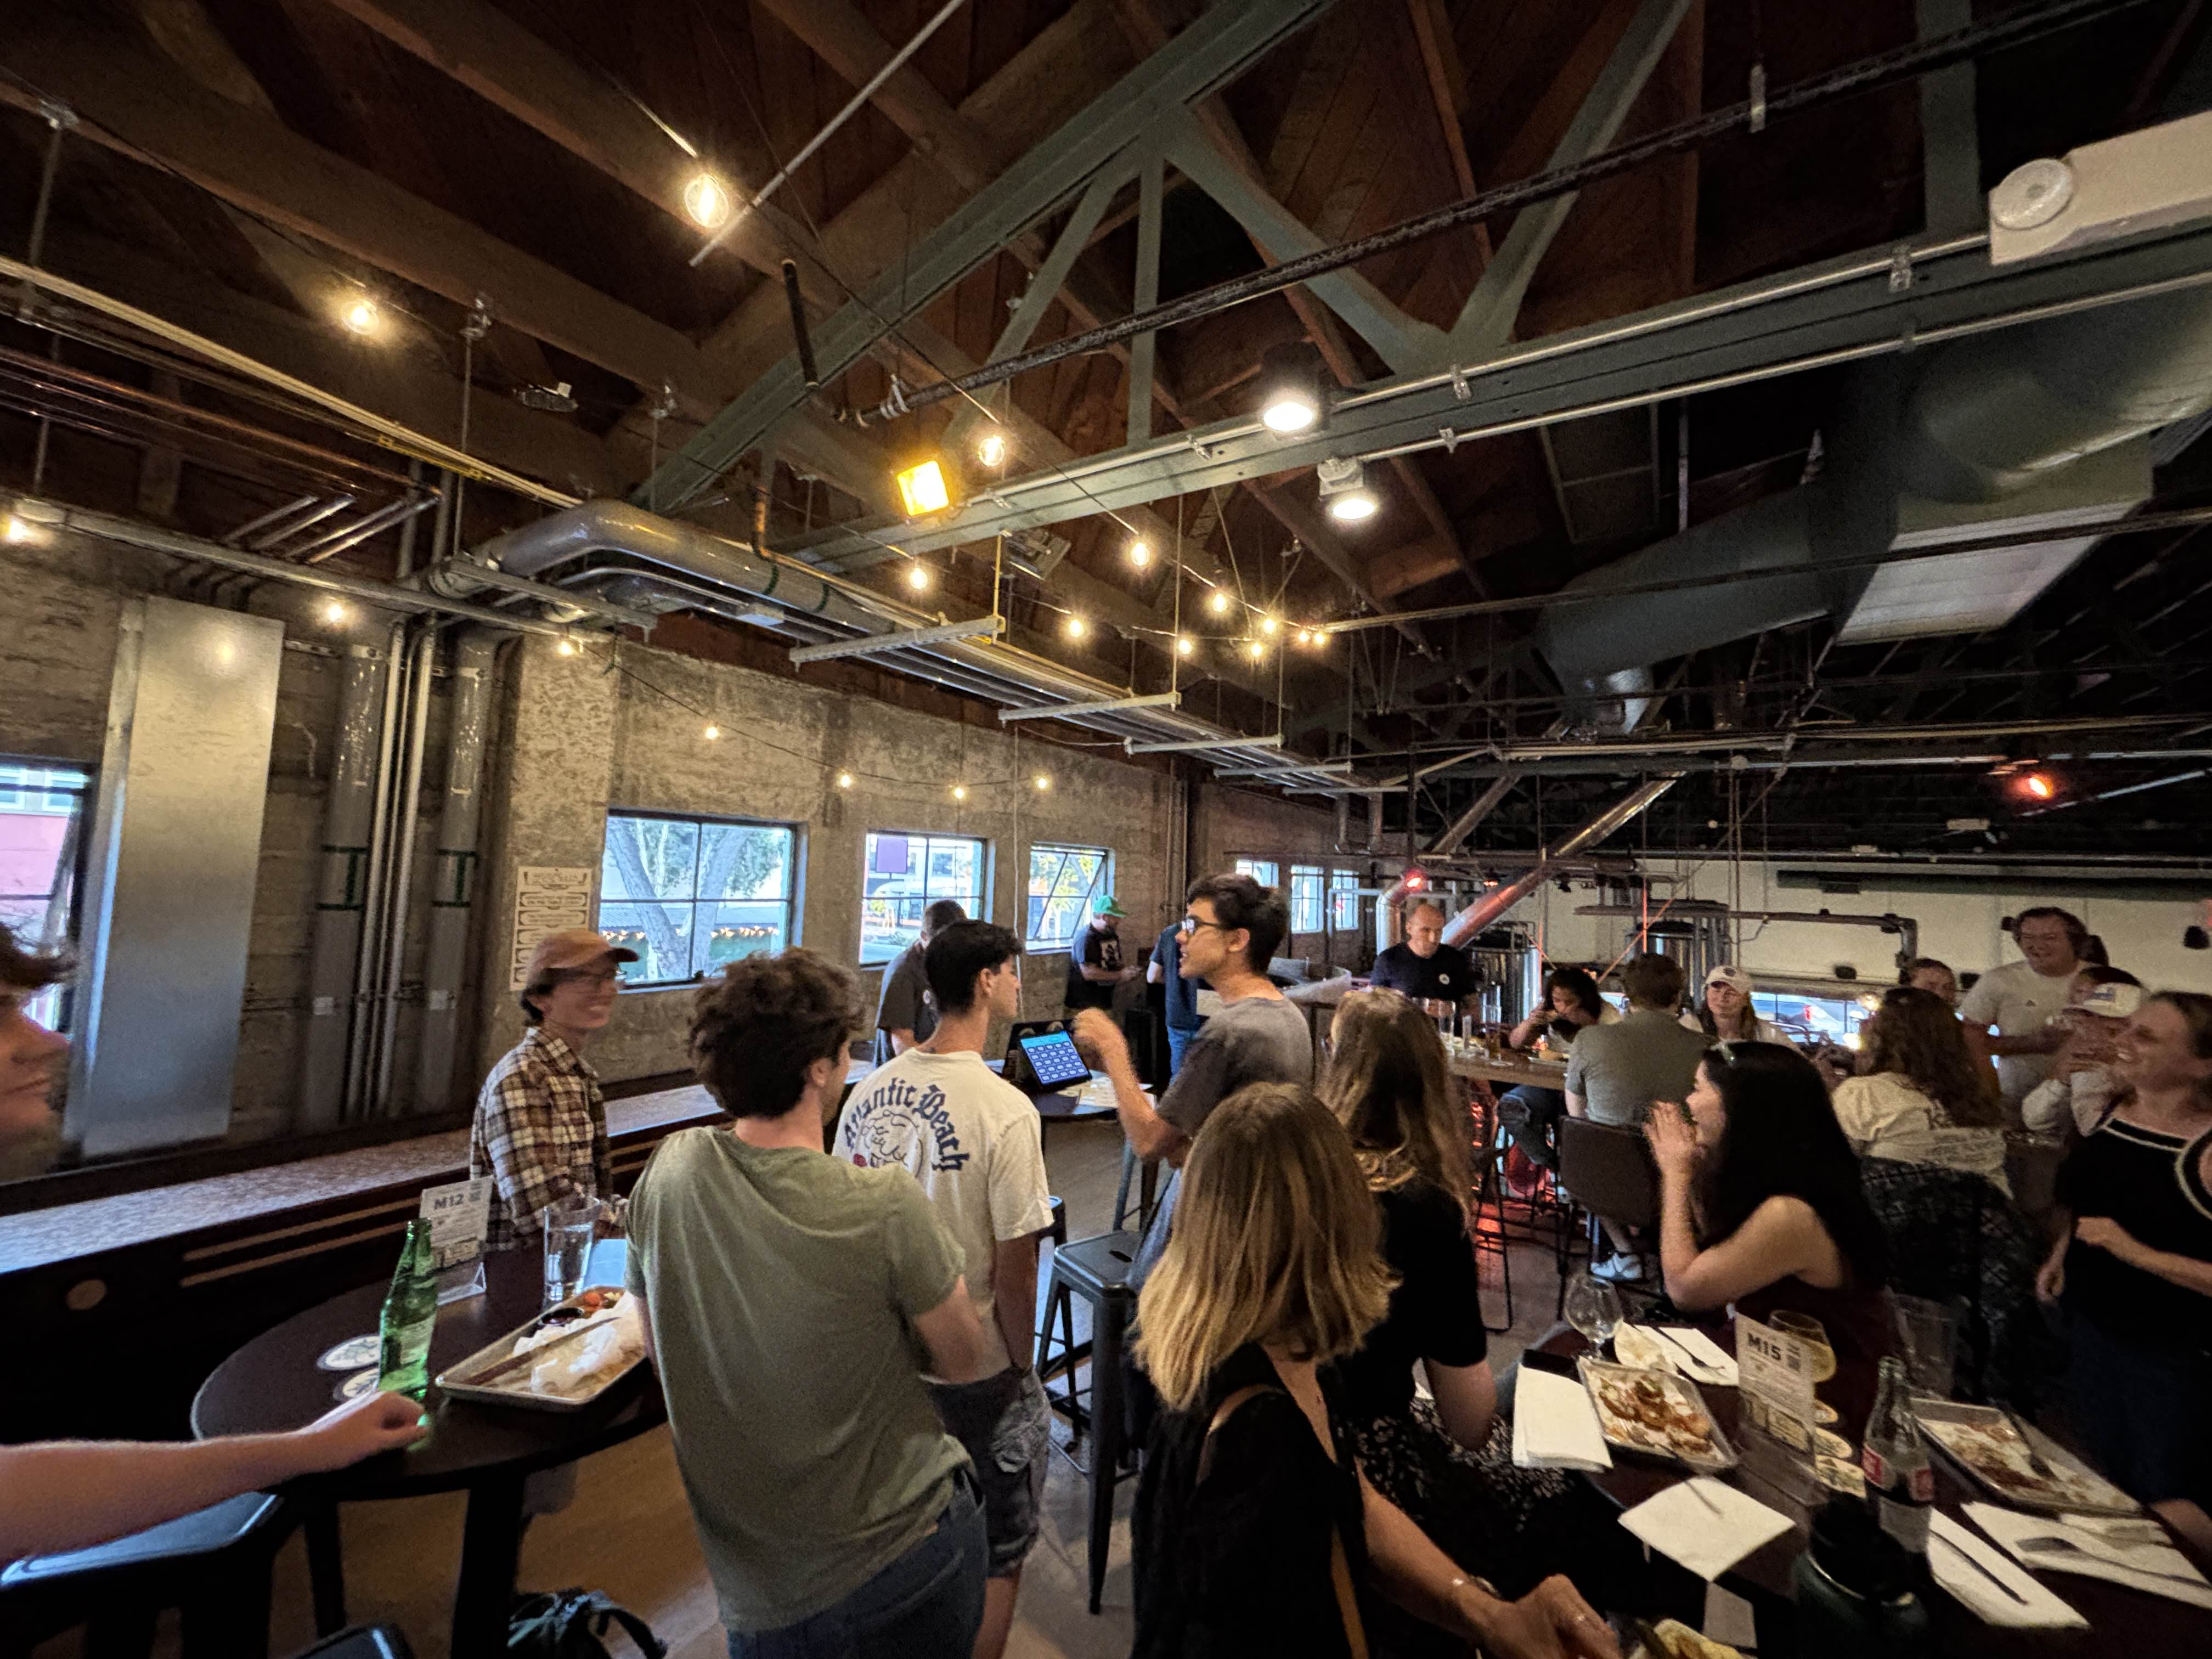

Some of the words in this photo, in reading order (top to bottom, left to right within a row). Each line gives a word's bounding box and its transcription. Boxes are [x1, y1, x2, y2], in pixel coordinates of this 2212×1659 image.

[845, 1077, 917, 1150] Atlantic
[912, 1085, 970, 1172] Beach
[434, 1193, 465, 1210] M12
[1747, 1332, 1781, 1361] M15
